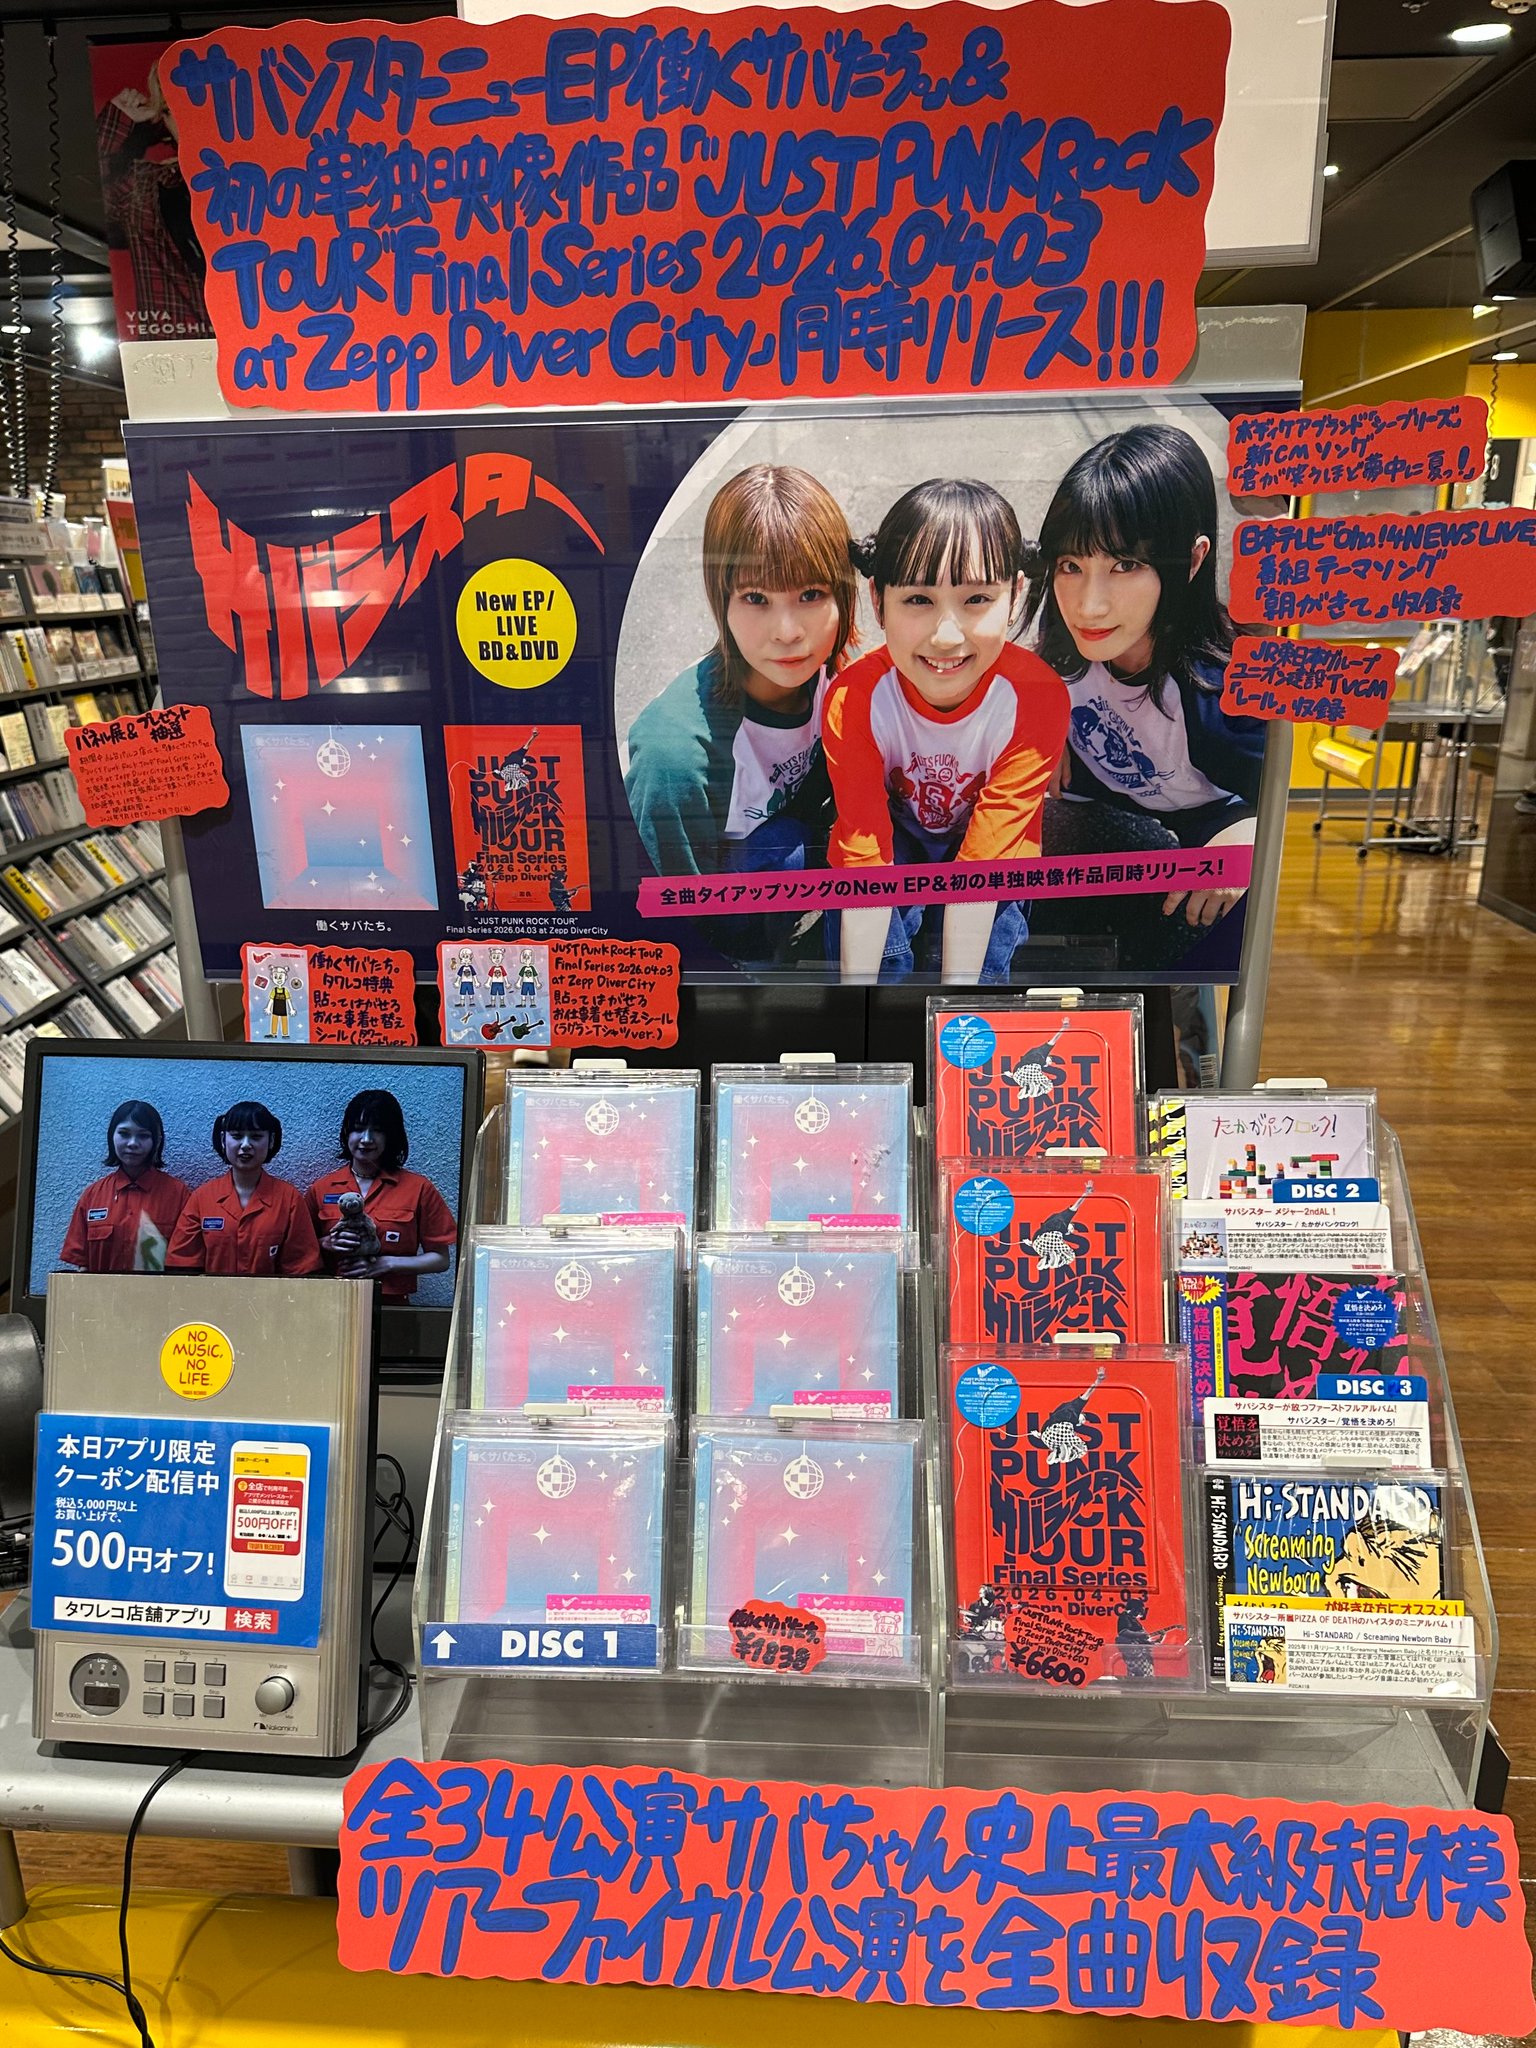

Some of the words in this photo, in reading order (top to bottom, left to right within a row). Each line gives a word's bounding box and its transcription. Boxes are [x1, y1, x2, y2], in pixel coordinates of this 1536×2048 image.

[394, 227, 528, 316] Final
[531, 223, 706, 308] Series
[712, 199, 1102, 299] 2026.04.03
[126, 311, 172, 322] YUYA
[234, 334, 297, 391] at
[298, 315, 438, 412] Zepp
[475, 591, 517, 611] New
[523, 590, 555, 611] EP/
[497, 616, 537, 636] LIVE
[479, 640, 559, 661] BD&DVD
[137, 707, 190, 729] プレゼント
[150, 721, 185, 743] 抽選
[476, 851, 513, 864] Final
[516, 851, 567, 864] Series
[492, 873, 518, 882] Zepp
[660, 877, 898, 907] 全曲タイアップソングのNew
[904, 859, 1224, 894] EP&初の単独映像作品同時リリース!
[316, 920, 392, 932] 働くサバたち。
[502, 917, 524, 926] PUNK
[526, 917, 549, 926] ROCK
[446, 926, 467, 934] Final
[468, 926, 492, 934] Series
[494, 926, 537, 934] 2026.04.03
[539, 926, 548, 934] at
[549, 926, 569, 935] Zepp
[570, 926, 608, 936] DiverCity
[551, 943, 581, 956] JUST
[581, 945, 608, 957] PUNK
[310, 950, 400, 974] 働くサバたち。
[554, 958, 582, 970] Final
[584, 959, 615, 972] Series
[617, 962, 674, 975] 2026.04.03
[323, 973, 395, 994] タワレコ特典
[551, 974, 565, 985] at
[568, 975, 594, 988] Zepp
[313, 990, 401, 1013] 貼ってはがせる
[553, 991, 648, 1008] 貼ってはがせる
[313, 1010, 405, 1030] お仕事着せ替え
[553, 1006, 674, 1026] お仕事着せ替えシール
[553, 1021, 663, 1041] (ラグランTシャツver.)
[1212, 1112, 1338, 1138] たかがパンクロック!
[1291, 1184, 1337, 1198] DISC
[1345, 1184, 1360, 1198] 2
[1224, 1207, 1272, 1216] サバシスター
[1255, 1220, 1292, 1228] サバシスター
[1301, 1220, 1359, 1228] たかがパンクロック!
[1344, 1304, 1386, 1312] 覚悟を決めろ!
[188, 1331, 207, 1342] NO
[173, 1344, 223, 1358] MUSIC,
[187, 1359, 206, 1370] NO
[179, 1372, 213, 1386] LIFE.
[1336, 1379, 1385, 1396] DISC
[1399, 1380, 1412, 1396] 3
[1234, 1402, 1398, 1413] サバシスターが放つファーストフルアルバム!
[1217, 1415, 1259, 1432] 覚悟を
[57, 1434, 216, 1465] 本日アプリ限定
[54, 1465, 219, 1496] クーポン配信中
[248, 1482, 288, 1493] 全店で利用可能
[55, 1497, 138, 1512] 税込5,000円以上
[55, 1508, 122, 1523] お買い上げで、
[237, 1516, 297, 1531] 500円OFF!
[1210, 1495, 1228, 1571] Hi-STANDARD
[51, 1528, 215, 1576] 500円オフ!
[994, 1565, 1061, 1586] Final
[1062, 1565, 1147, 1587] Series
[1246, 1563, 1321, 1597] Newborn
[65, 1601, 211, 1625] タワレコ店舗アプリ
[234, 1610, 272, 1631] 検索
[1232, 1611, 1317, 1624] サバシスター所属PIZZA
[1319, 1615, 1330, 1624] OF
[1014, 1616, 1034, 1630] Final
[1034, 1624, 1056, 1638] Series
[1043, 1615, 1064, 1629] PUNK
[1230, 1624, 1285, 1637] Hi-STANDARD
[1024, 1628, 1044, 1642] Zepp
[1303, 1630, 1354, 1639] Hi-STANDARD
[1363, 1632, 1399, 1642] Screaming
[1401, 1634, 1432, 1643] Newborn
[1434, 1635, 1452, 1645] Baby
[500, 1631, 583, 1658] DISC
[604, 1631, 618, 1658] 1
[735, 1630, 811, 1671] ¥1838
[1009, 1642, 1086, 1686] ¥6600
[265, 1723, 298, 1732] Nakamichi
[347, 1758, 1511, 1928] 全34公演サバちゃん史上最大級規模
[358, 1866, 1385, 2029] ツアーファイナル公演を全曲収録
